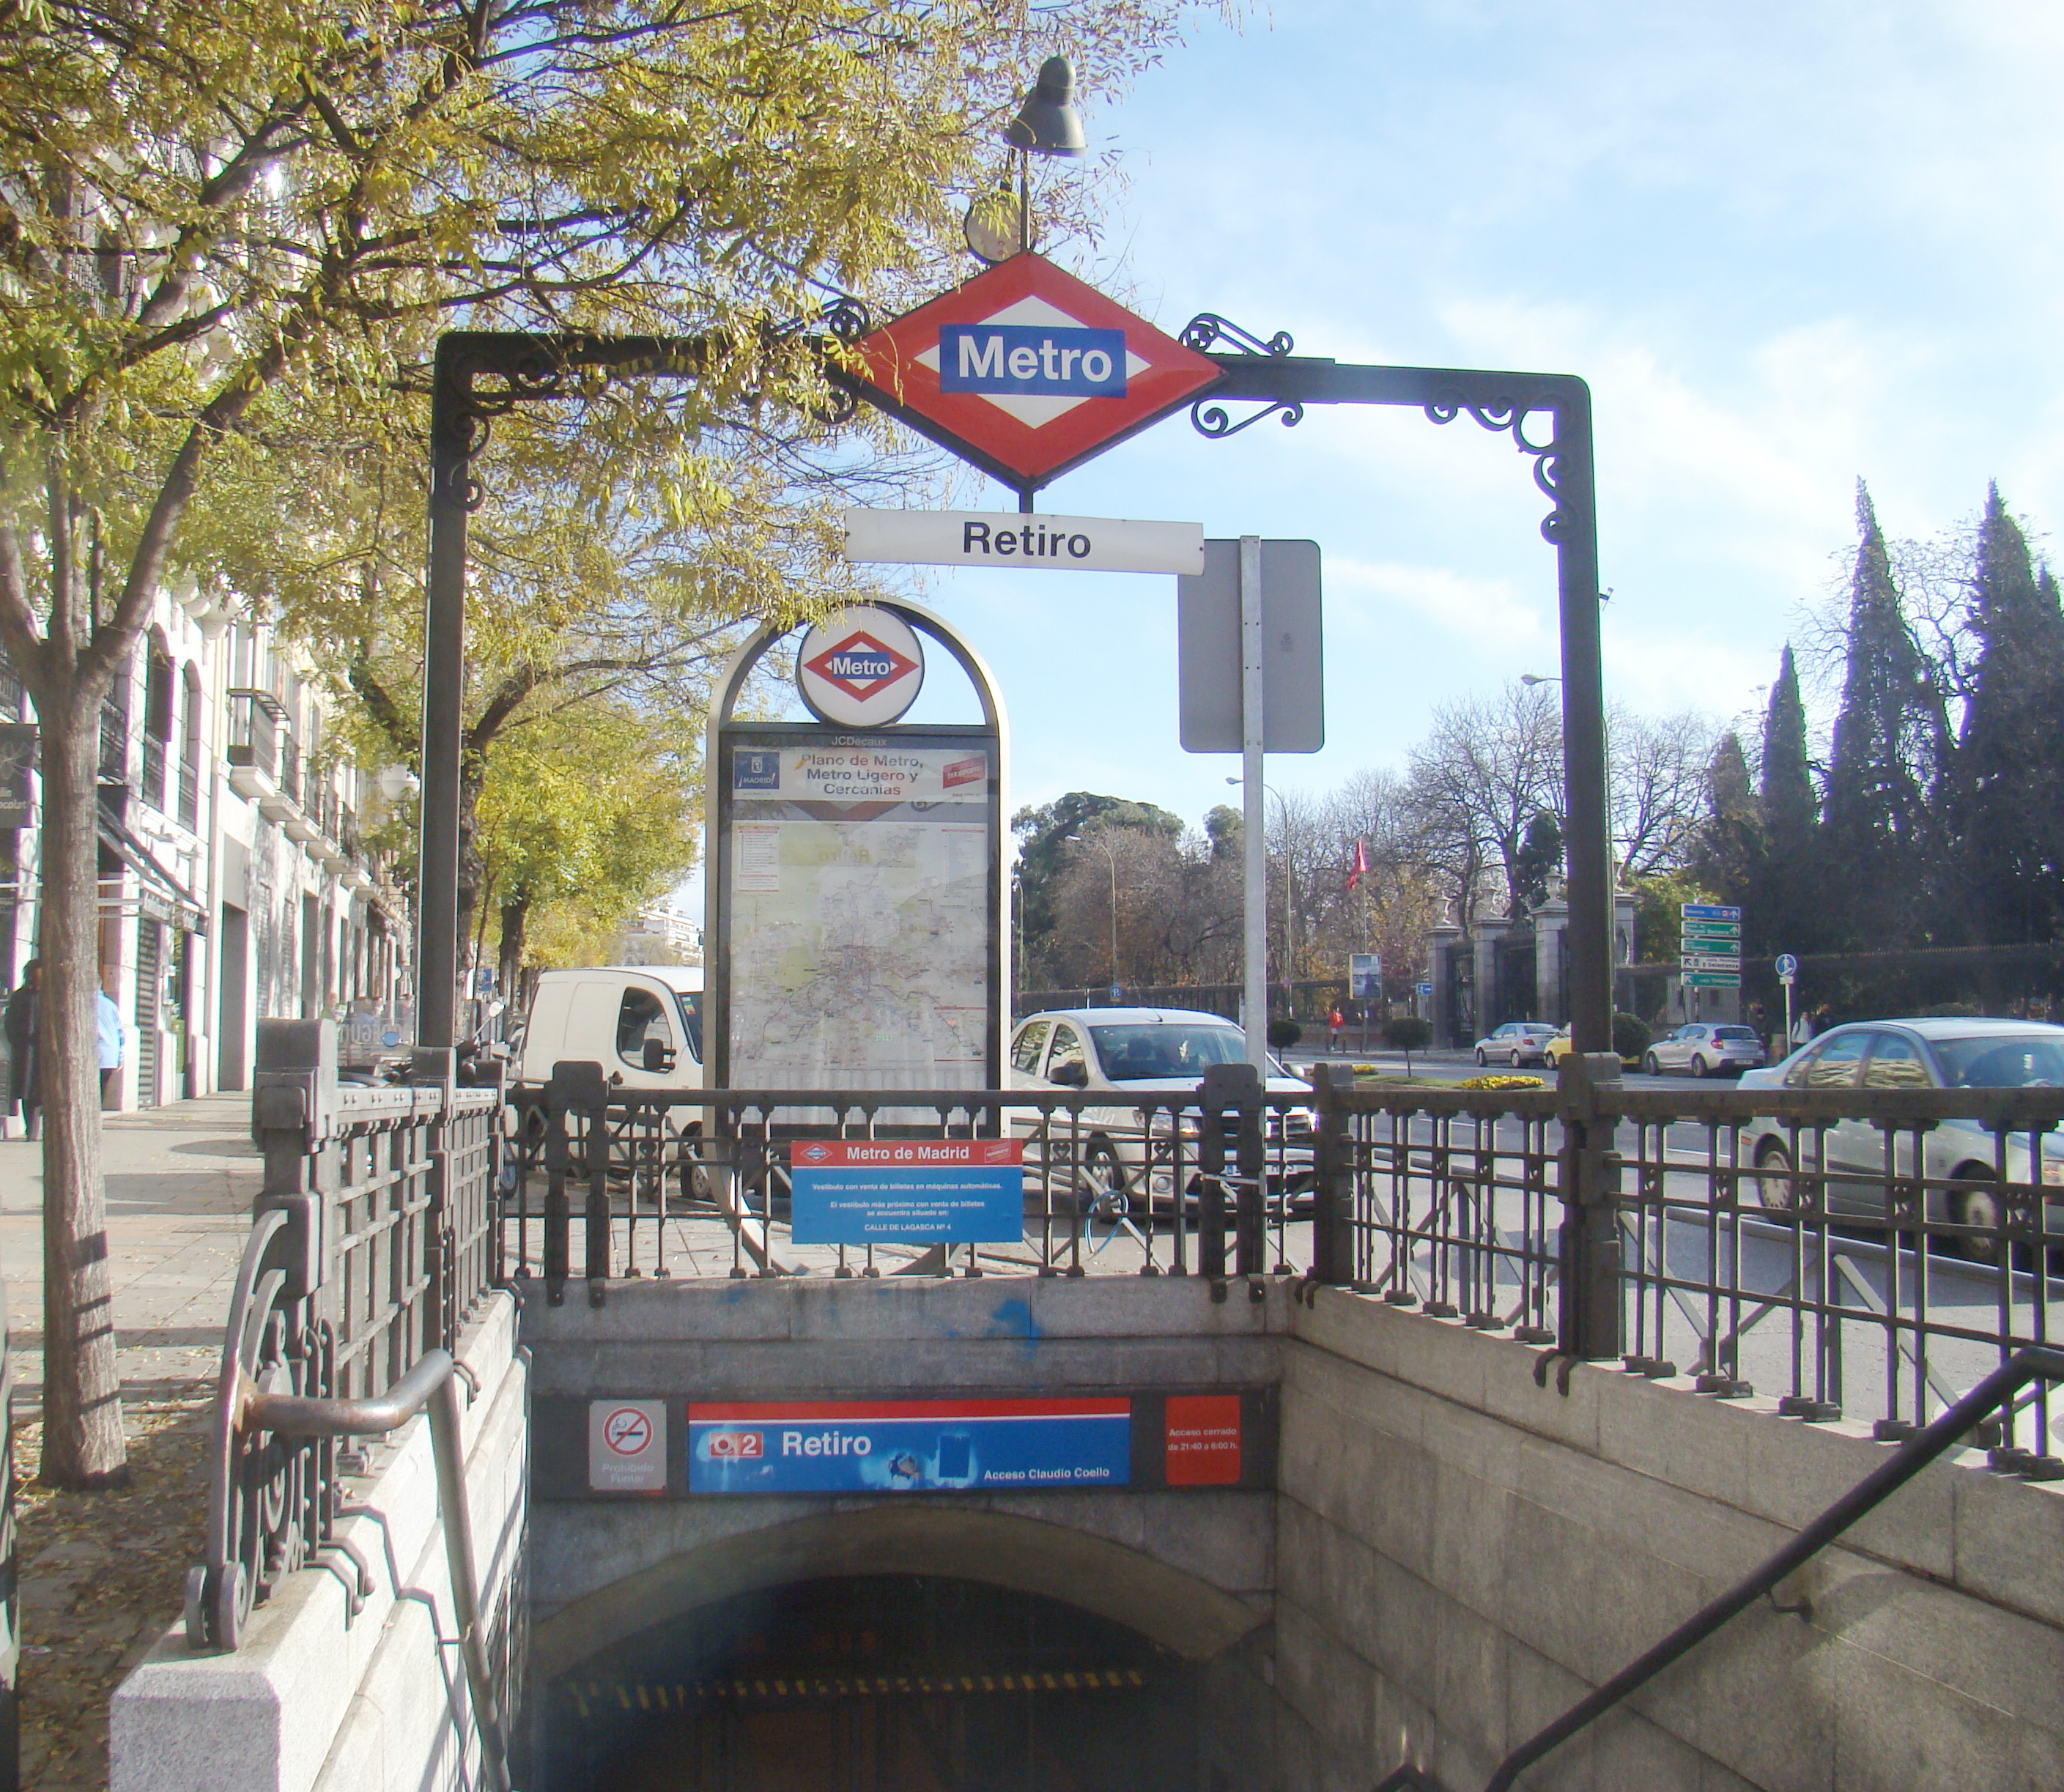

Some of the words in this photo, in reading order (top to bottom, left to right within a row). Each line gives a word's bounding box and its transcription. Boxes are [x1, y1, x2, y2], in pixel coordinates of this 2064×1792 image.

[958, 335, 1112, 383] Metro
[963, 522, 1091, 558] Retiro
[832, 656, 890, 676] Metro
[832, 736, 887, 747] JCDecaux
[850, 754, 868, 766] de
[874, 755, 924, 769] Metro,
[807, 769, 851, 780] Metro
[857, 769, 905, 783] Ligero
[909, 773, 918, 782] y
[824, 783, 901, 796] Cercanías
[846, 1146, 890, 1160] Metro
[895, 1146, 913, 1160] de
[917, 1145, 969, 1160] Madrid
[1169, 1428, 1201, 1437] Acceso
[1203, 1427, 1237, 1436] cerrado
[742, 1434, 757, 1454] 2
[783, 1431, 872, 1456] Retiro
[1180, 1442, 1202, 1451] 21:40
[983, 1469, 1026, 1480] Acceso
[1028, 1467, 1071, 1479] Claudio
[1073, 1466, 1110, 1478] Coello
